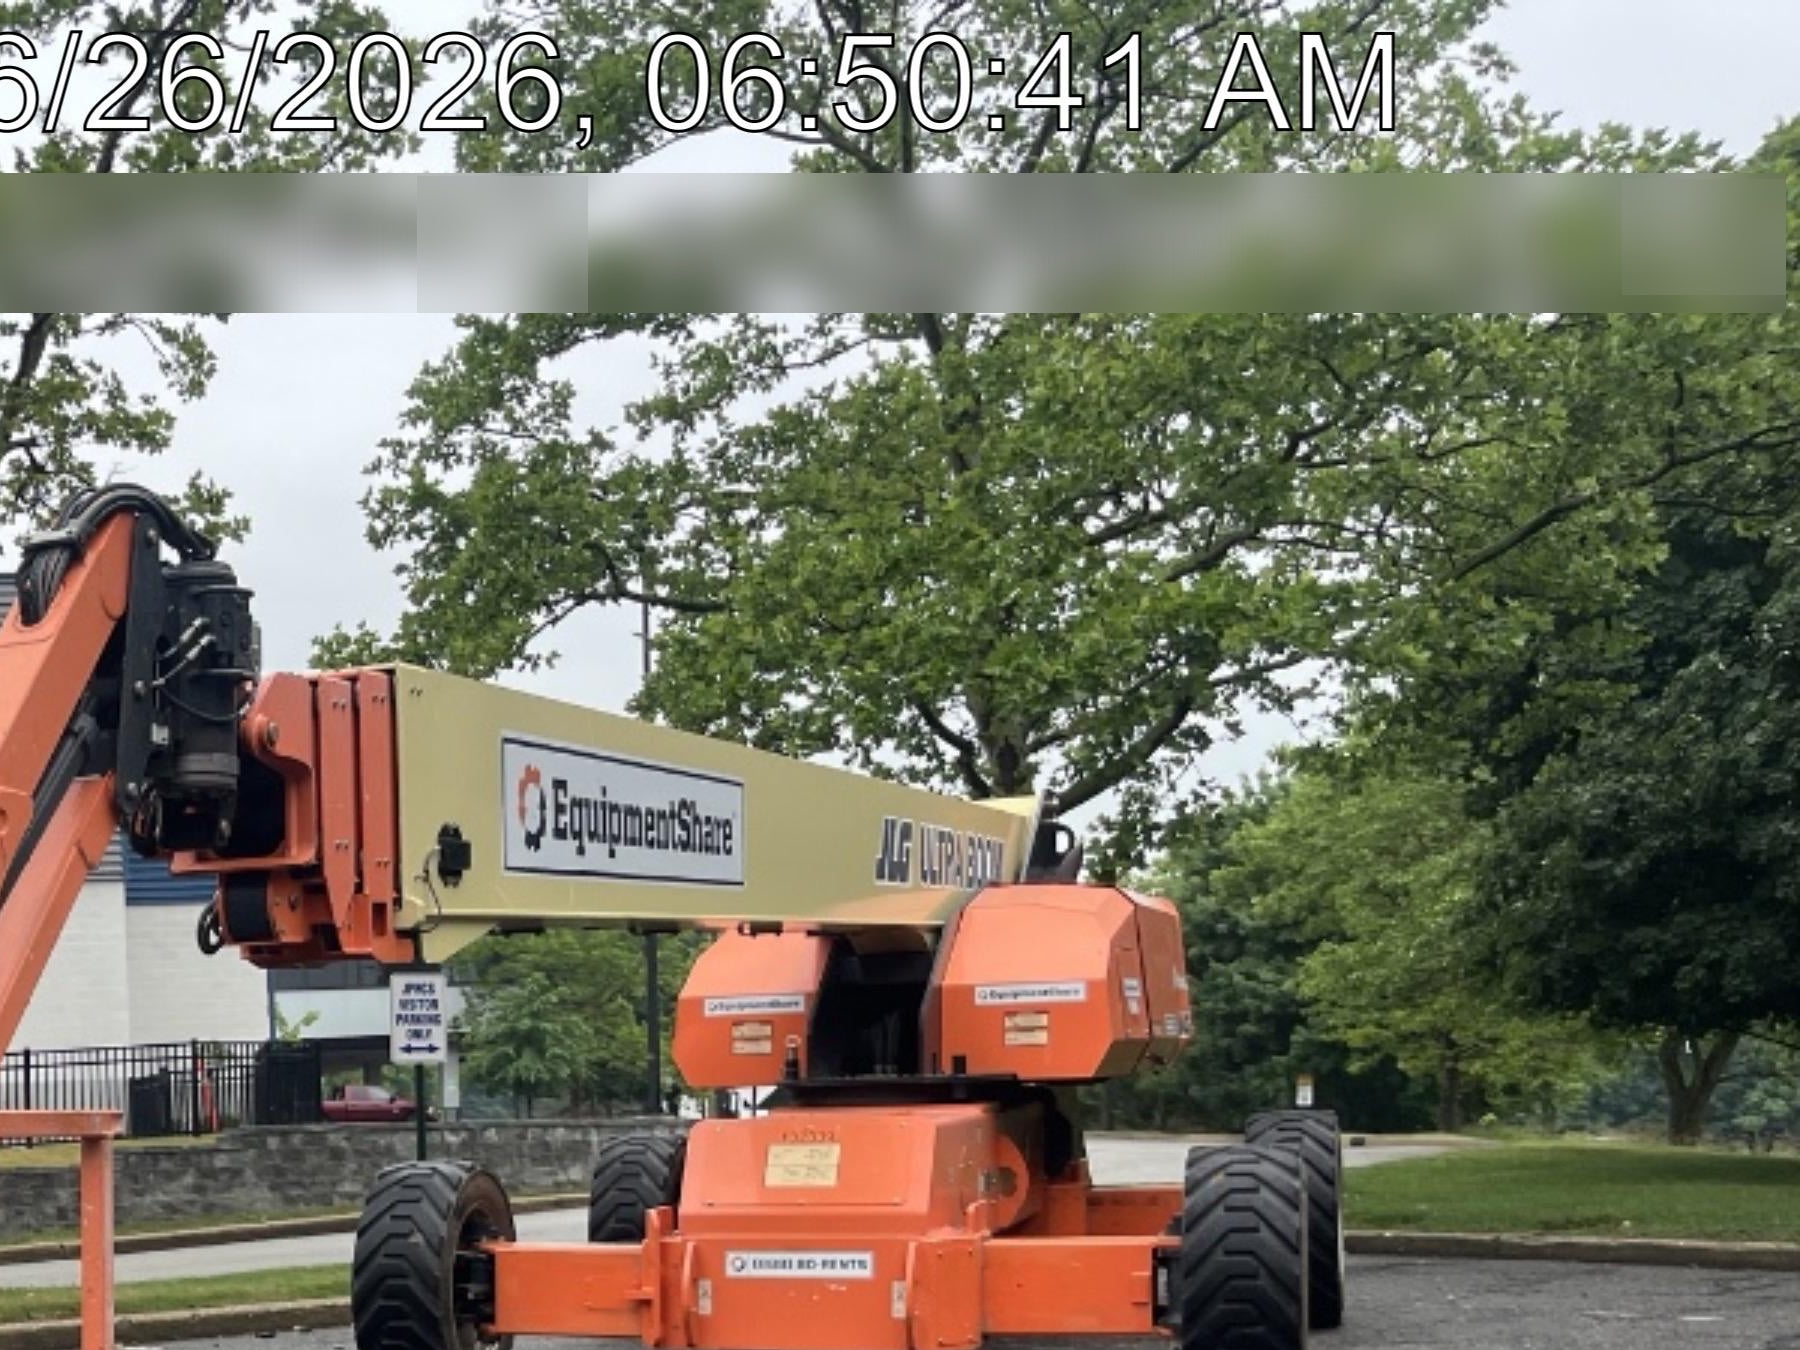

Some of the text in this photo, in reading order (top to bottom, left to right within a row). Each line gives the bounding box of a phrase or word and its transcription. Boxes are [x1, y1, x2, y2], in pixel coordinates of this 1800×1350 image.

[551, 777, 734, 858] EquipmentShare
[875, 817, 913, 885] JLG
[399, 999, 439, 1011] VISITOR
[395, 1013, 442, 1026] PARKING
[406, 1028, 433, 1040] ONLY
